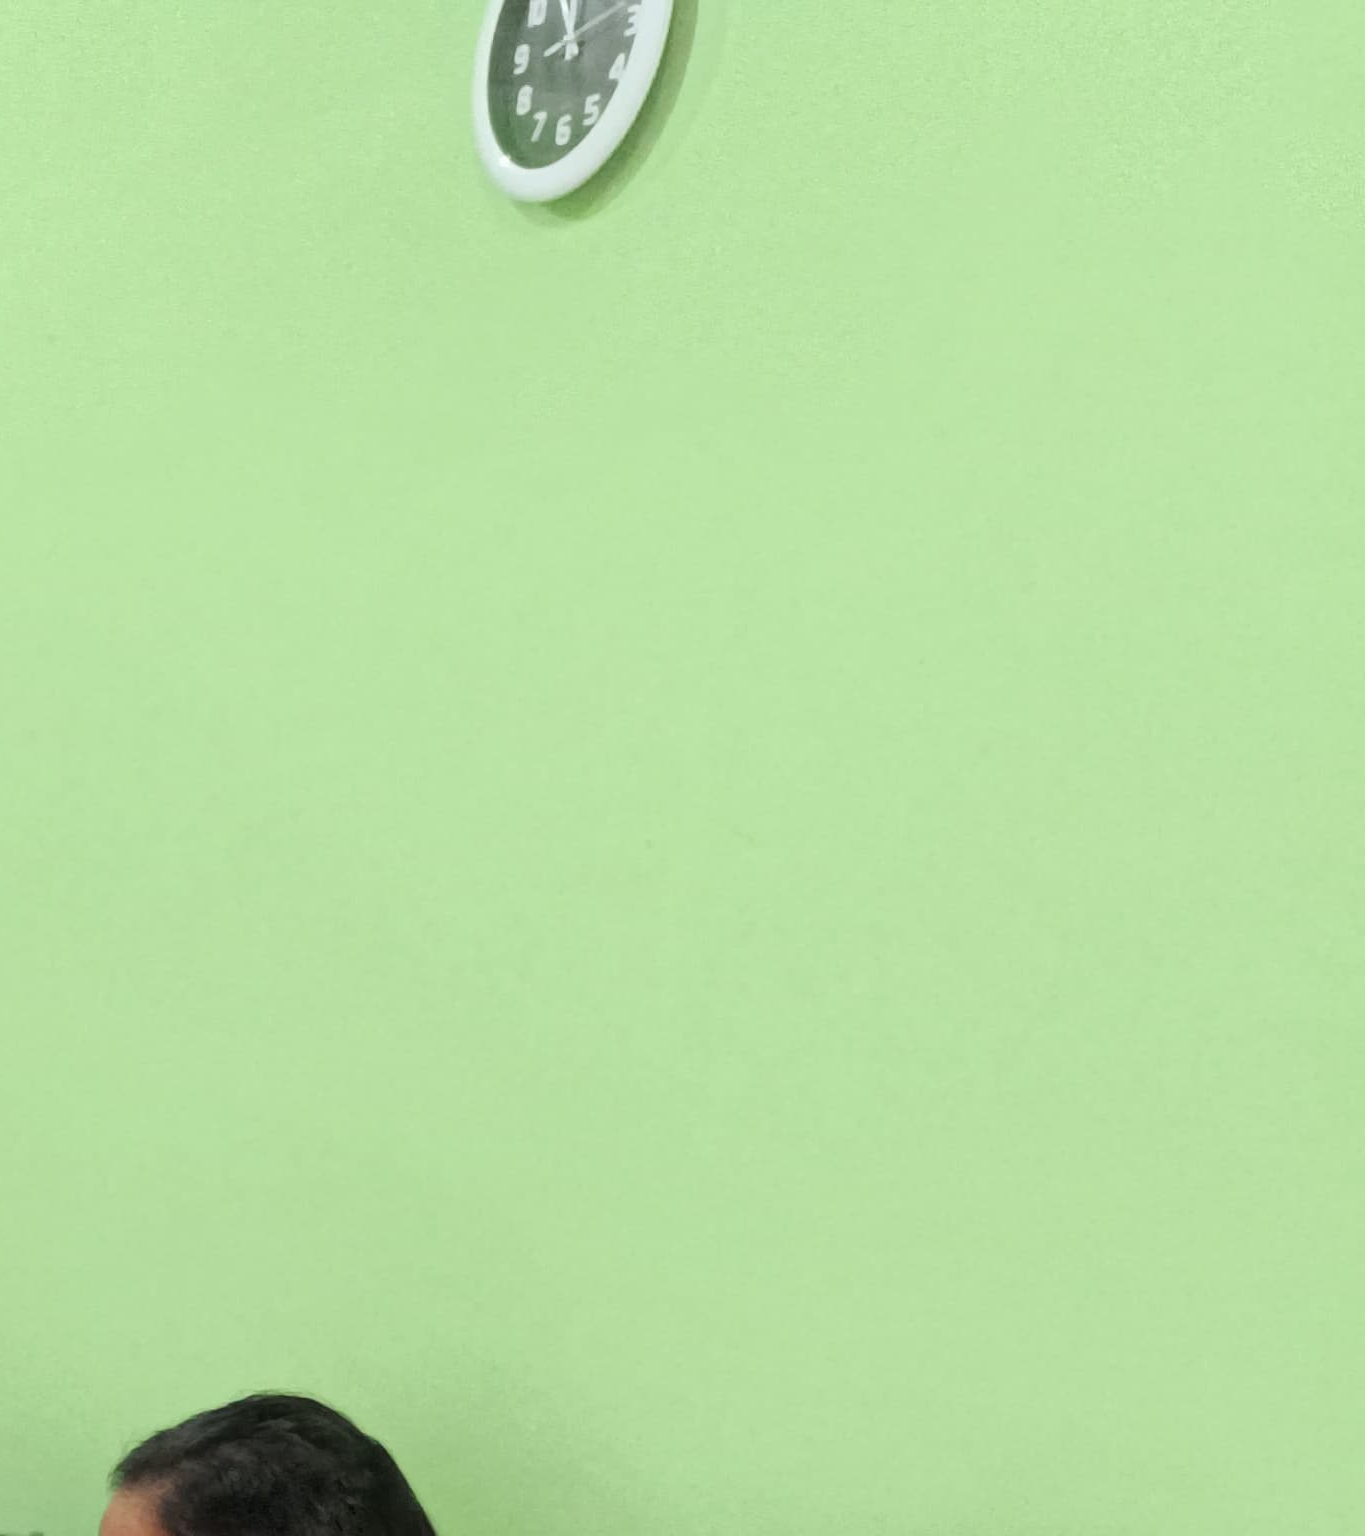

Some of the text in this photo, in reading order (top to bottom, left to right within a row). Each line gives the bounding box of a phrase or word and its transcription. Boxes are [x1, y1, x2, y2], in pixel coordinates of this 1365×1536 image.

[513, 43, 531, 76] 9
[516, 84, 534, 116] 8
[582, 94, 602, 127] 5
[531, 111, 548, 143] 7
[555, 115, 572, 146] 6
